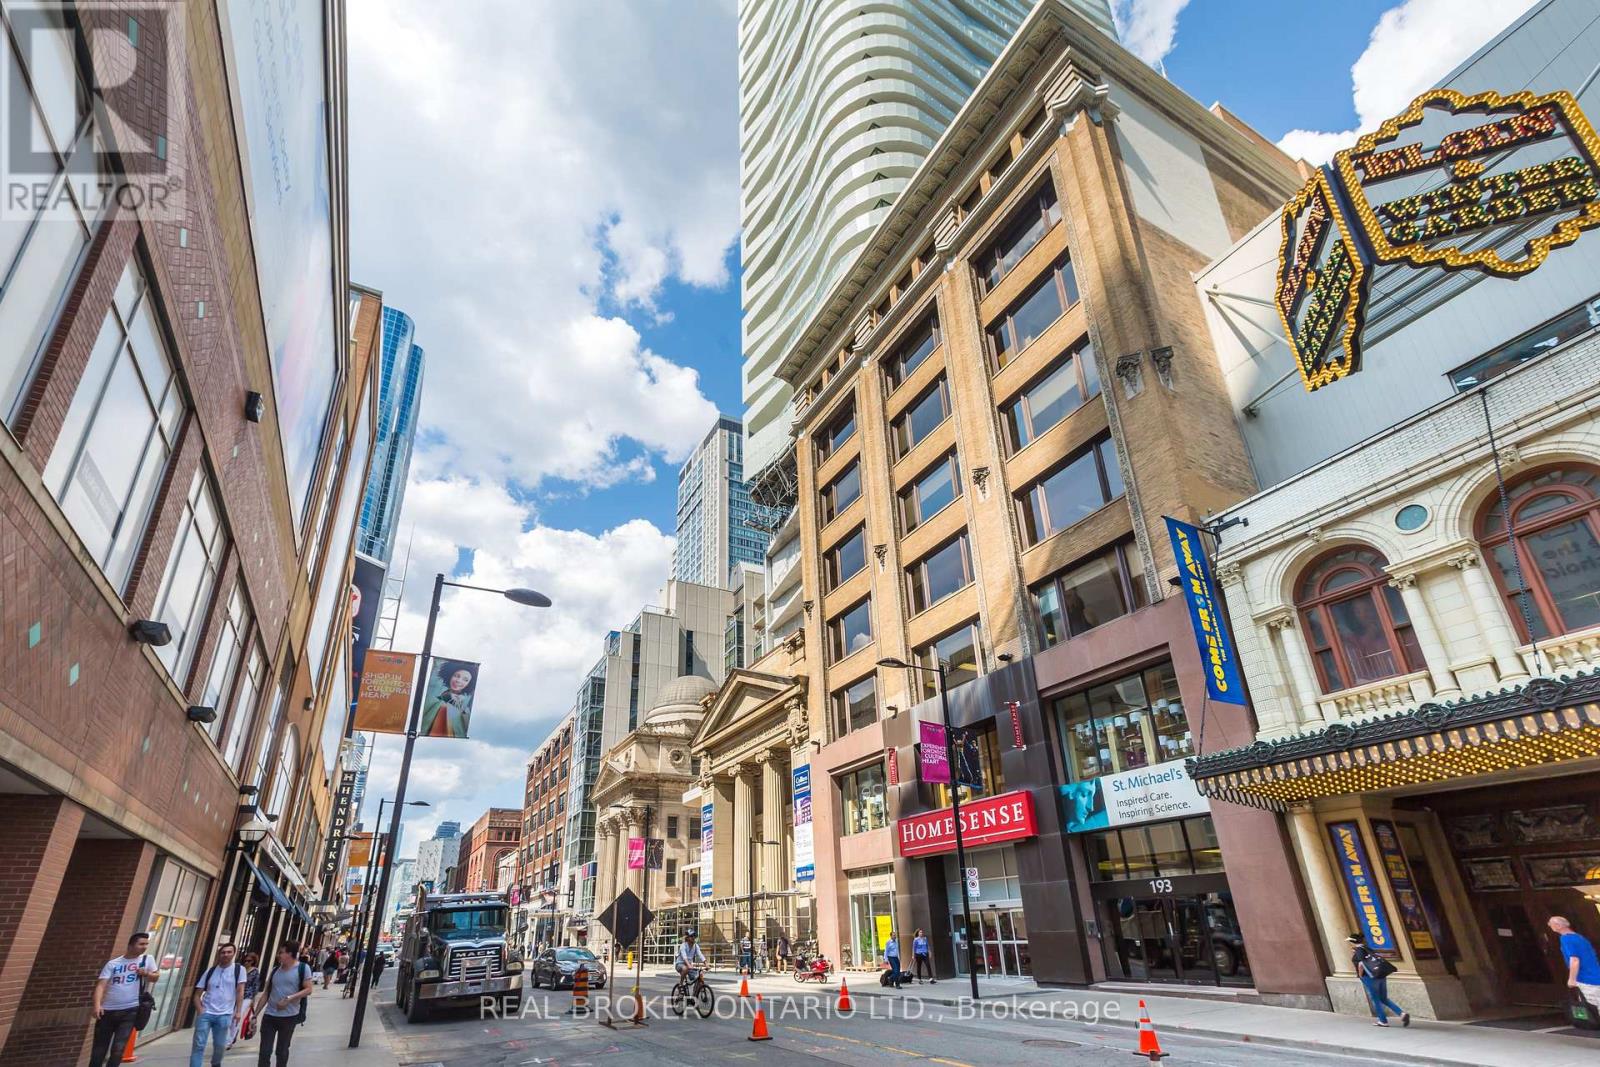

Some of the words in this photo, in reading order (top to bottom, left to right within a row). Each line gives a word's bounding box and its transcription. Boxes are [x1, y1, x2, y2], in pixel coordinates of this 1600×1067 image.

[1353, 106, 1556, 181] ELGIN
[1378, 156, 1591, 219] WINTER
[1389, 177, 1600, 243] GARDEN
[1176, 527, 1198, 577] AWAY
[364, 671, 391, 679] SHOP
[1205, 634, 1228, 693] COME
[360, 691, 391, 699] HEART
[1112, 780, 1127, 792] St.
[1128, 768, 1183, 788] Michael's
[1116, 793, 1149, 807] Inspired
[1150, 791, 1172, 802] Care.
[1119, 806, 1153, 819] Inspiring
[1155, 800, 1191, 813] Science.
[326, 786, 351, 871] HENDRIKS
[1338, 828, 1360, 863] AWAY
[1149, 879, 1173, 894] 193
[1363, 904, 1386, 945] COME
[113, 962, 140, 974] HIG
[456, 949, 496, 958] MACK
